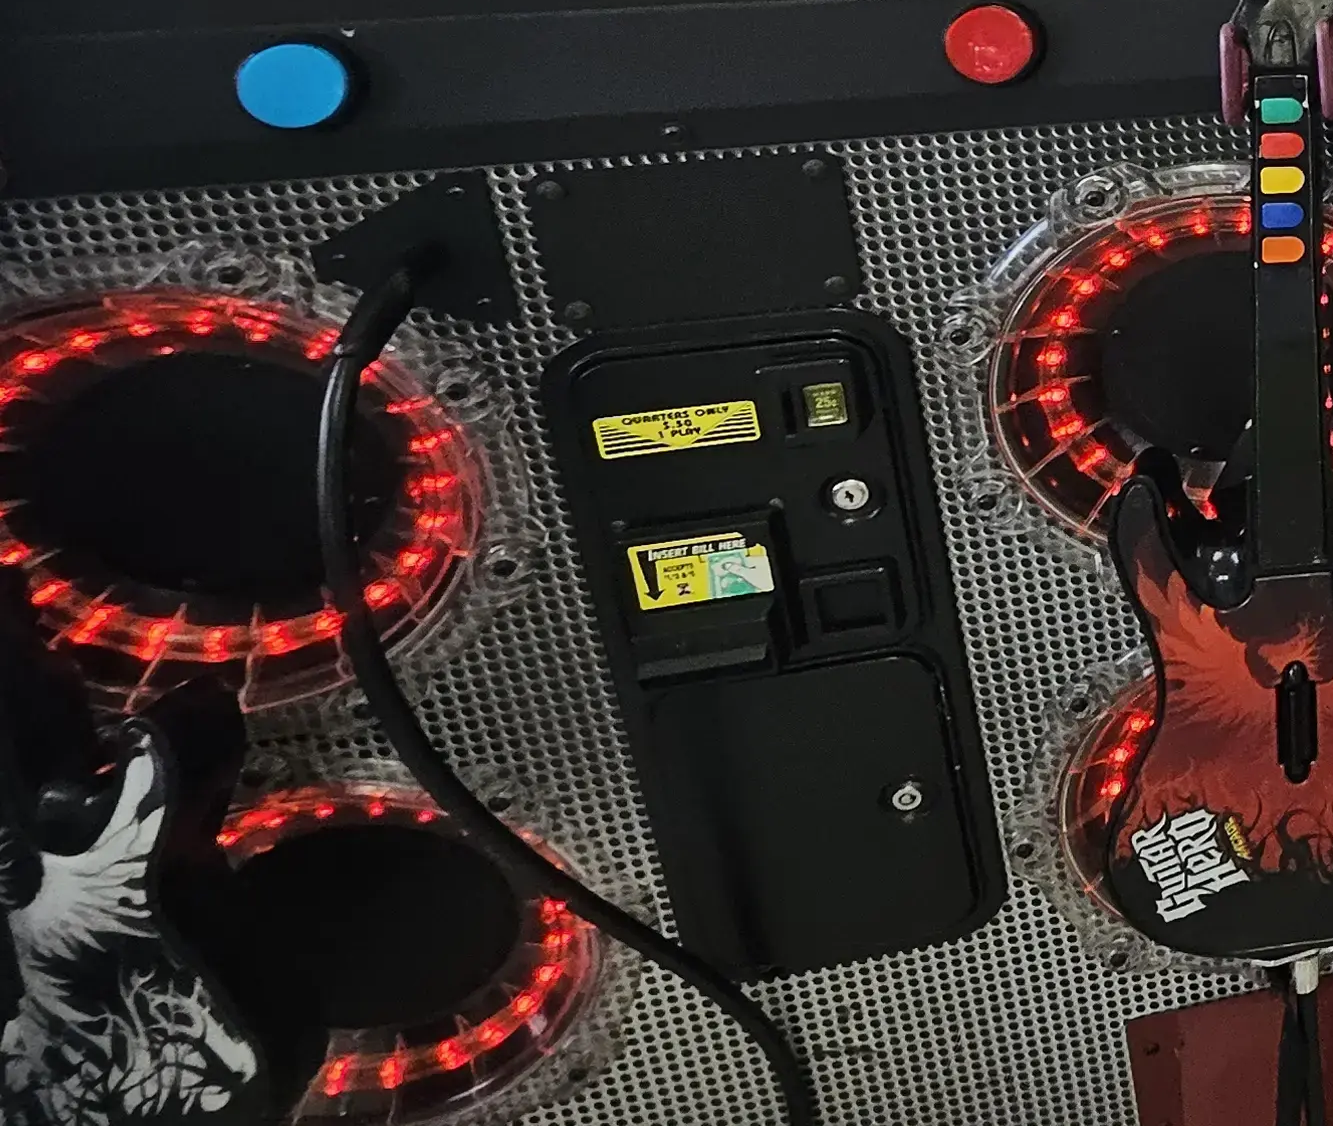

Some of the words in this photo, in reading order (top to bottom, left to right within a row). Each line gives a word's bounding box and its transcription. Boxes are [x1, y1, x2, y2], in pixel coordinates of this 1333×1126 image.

[621, 410, 689, 425] QUARTERS
[695, 406, 729, 417] ONLY
[670, 428, 701, 438] PLAY
[648, 545, 689, 561] INSERT
[691, 542, 715, 554] BILL
[719, 538, 746, 552] HERE
[1132, 812, 1211, 922] GUITAR
